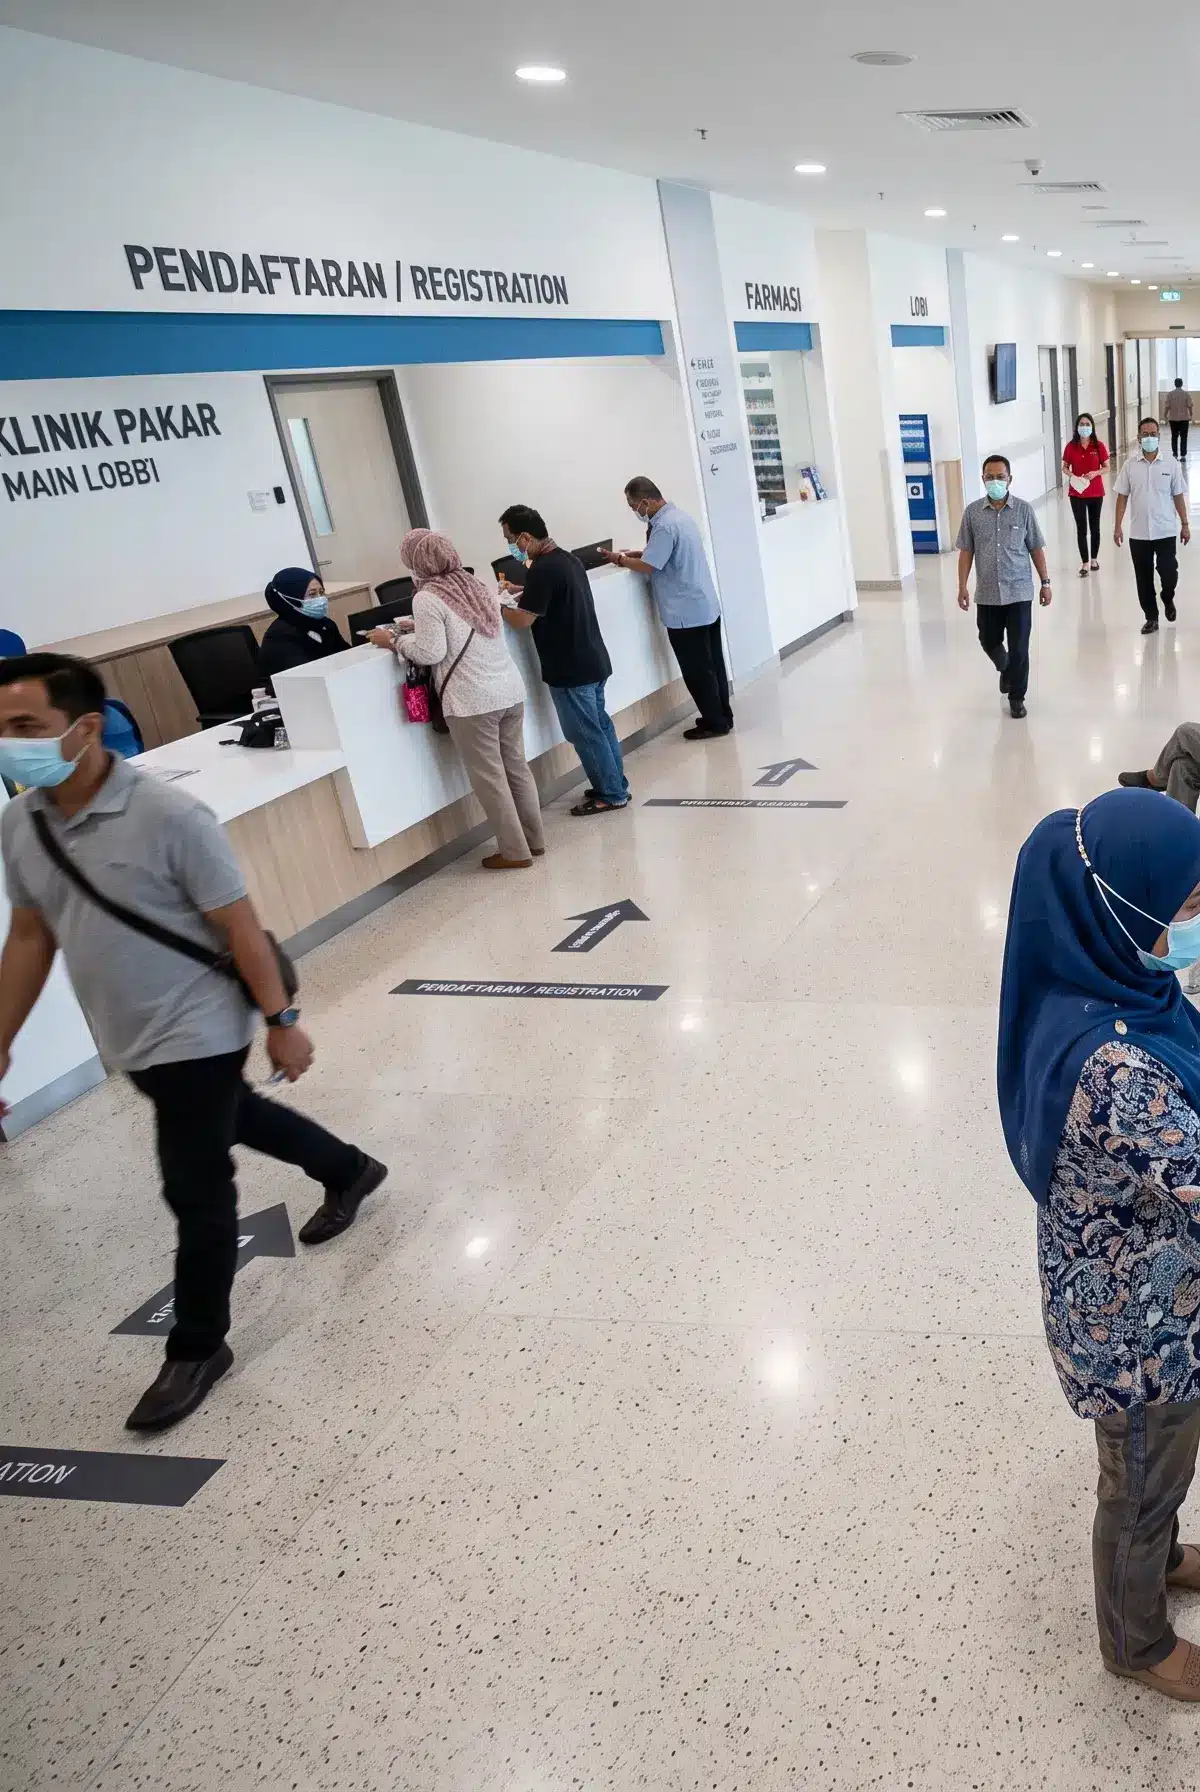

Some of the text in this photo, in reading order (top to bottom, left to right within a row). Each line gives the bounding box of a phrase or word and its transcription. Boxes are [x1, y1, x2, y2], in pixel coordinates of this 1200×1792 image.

[123, 244, 388, 299] PENDAFTARAN
[409, 265, 569, 305] REGISTRATION
[744, 282, 802, 312] FARMASI
[909, 296, 928, 317] LOBI
[114, 402, 222, 445] PAKAR
[2, 466, 80, 502] MAIN
[416, 983, 526, 994] PENDAFTARAN
[534, 986, 643, 998] REGISTRATION
